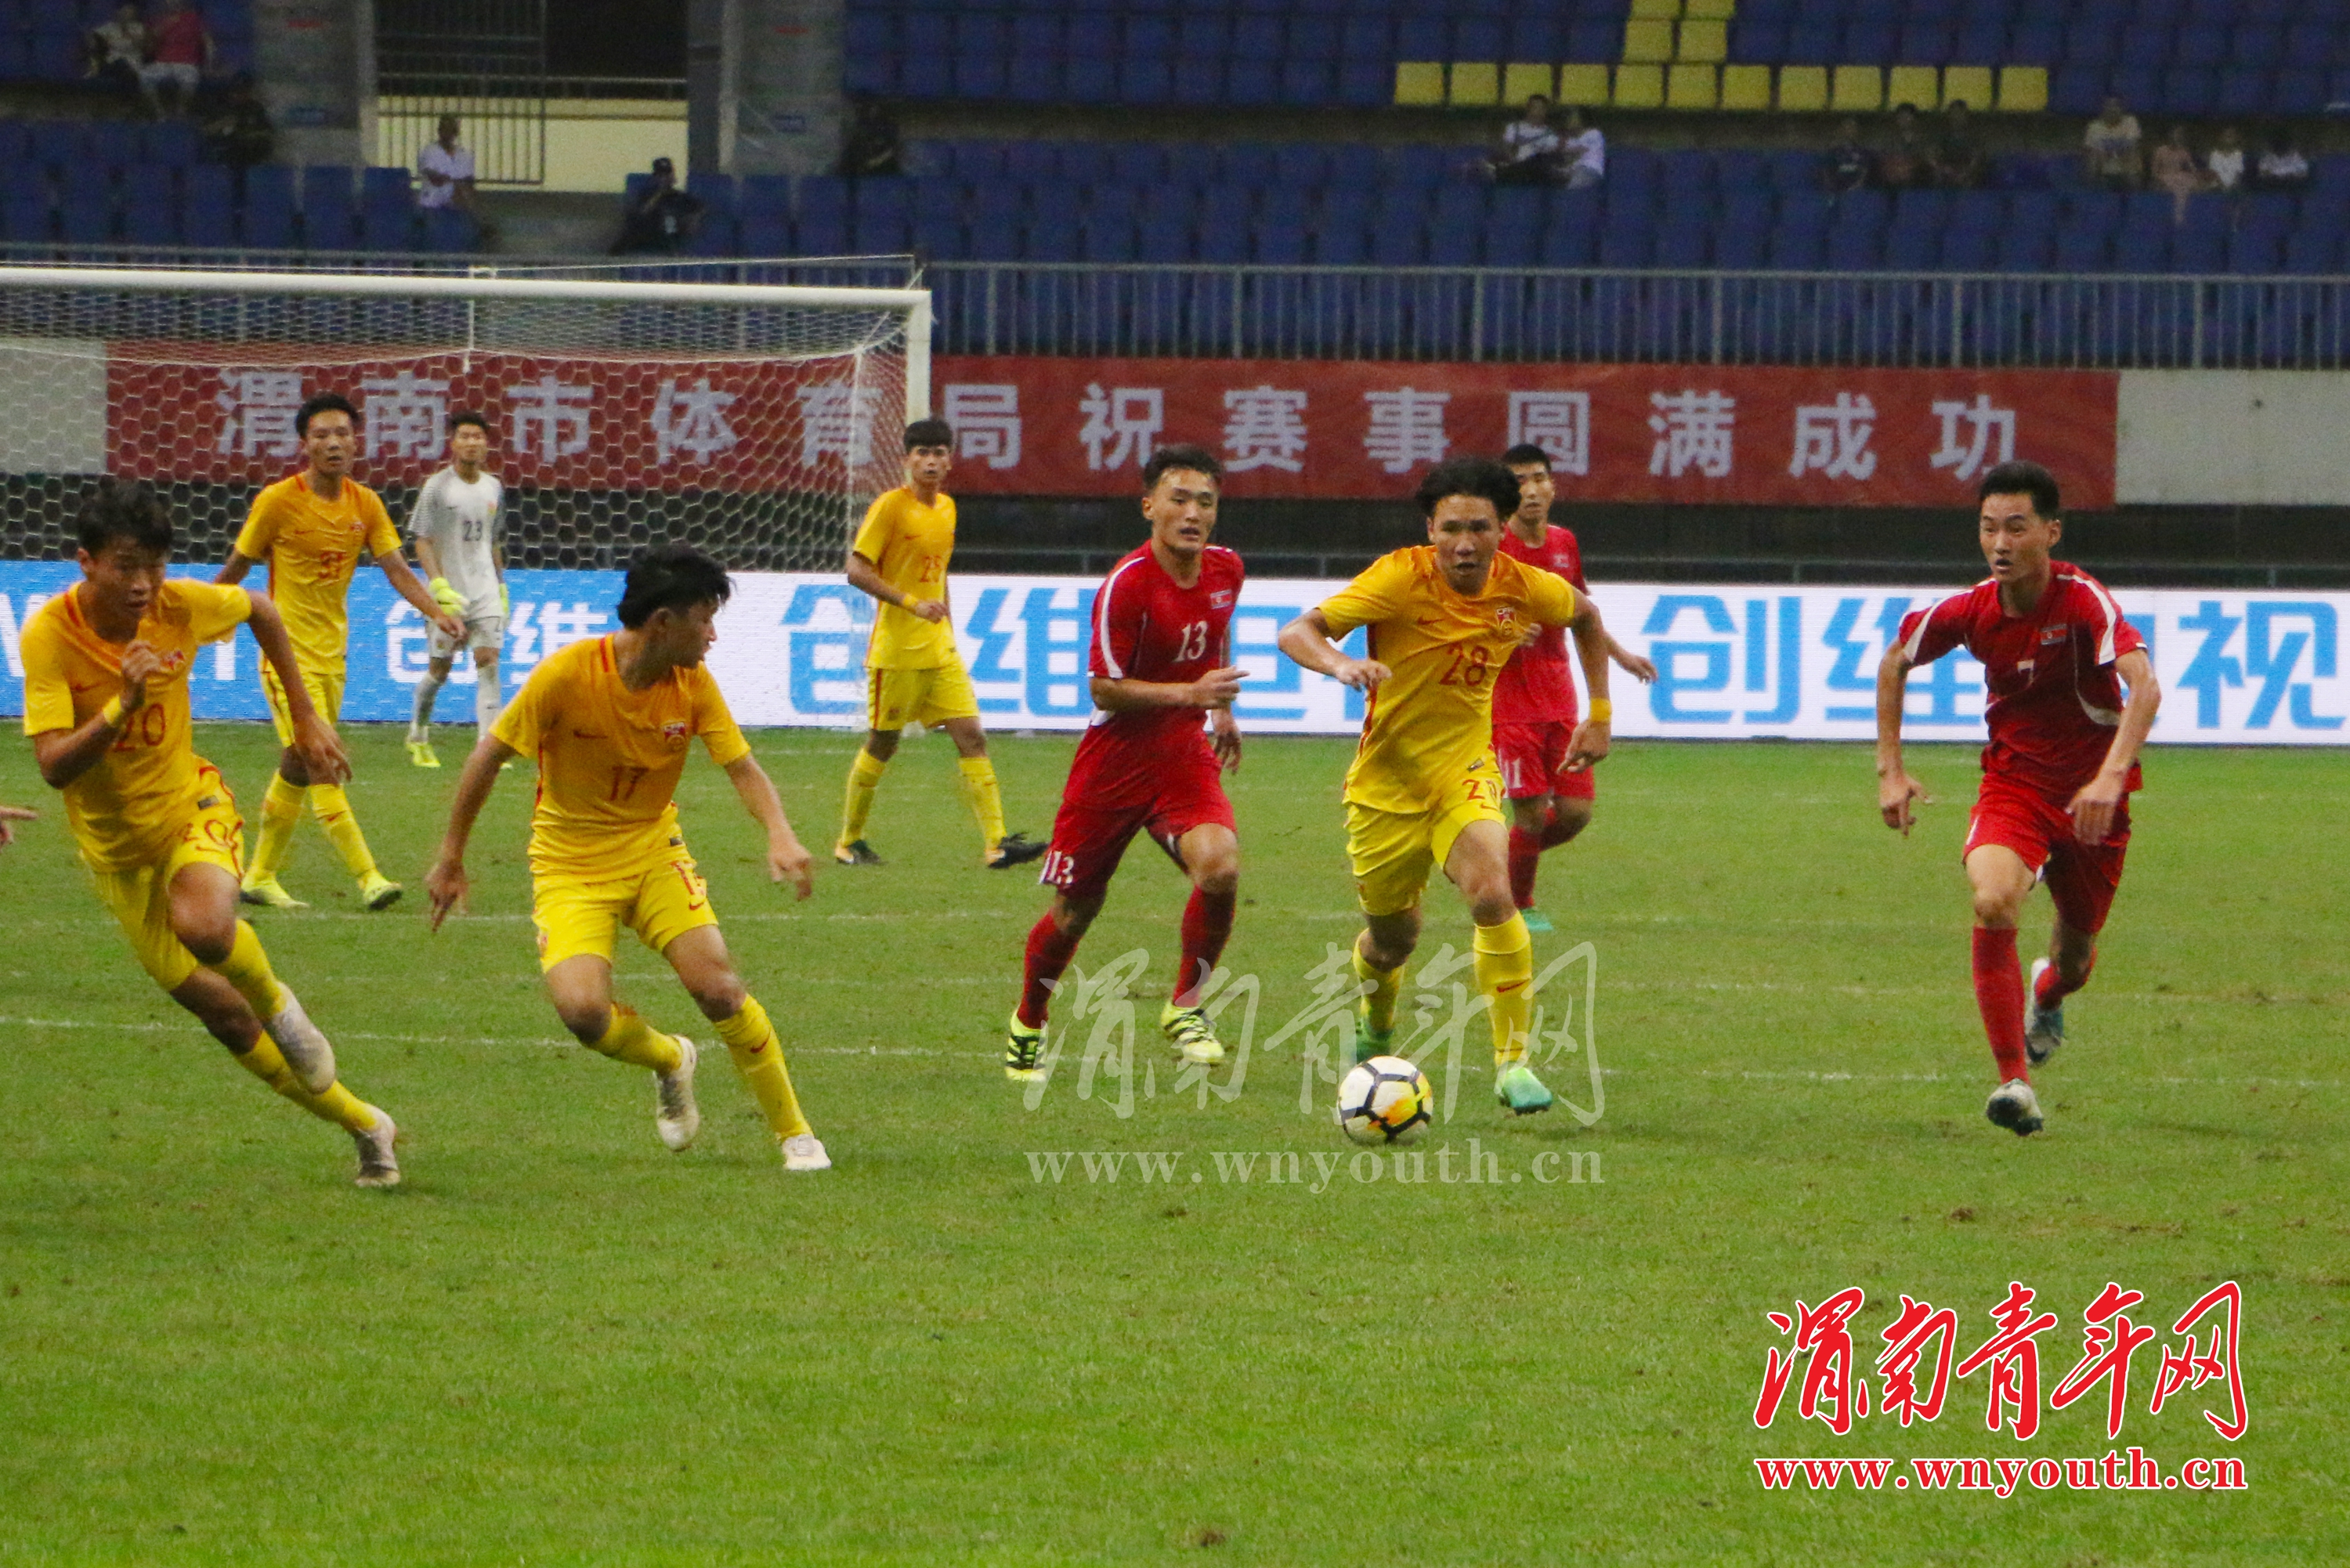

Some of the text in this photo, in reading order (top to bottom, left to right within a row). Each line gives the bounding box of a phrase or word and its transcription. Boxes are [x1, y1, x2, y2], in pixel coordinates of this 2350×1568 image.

[214, 365, 2016, 482] 渭南市体育局祝赛事圆满成功
[462, 519, 483, 542] 23
[1172, 620, 1208, 662] 13
[1641, 594, 2348, 730] 创维视
[1439, 641, 1489, 687] 28
[112, 703, 166, 752] 20
[609, 765, 649, 801] 17
[1047, 851, 1074, 887] 13
